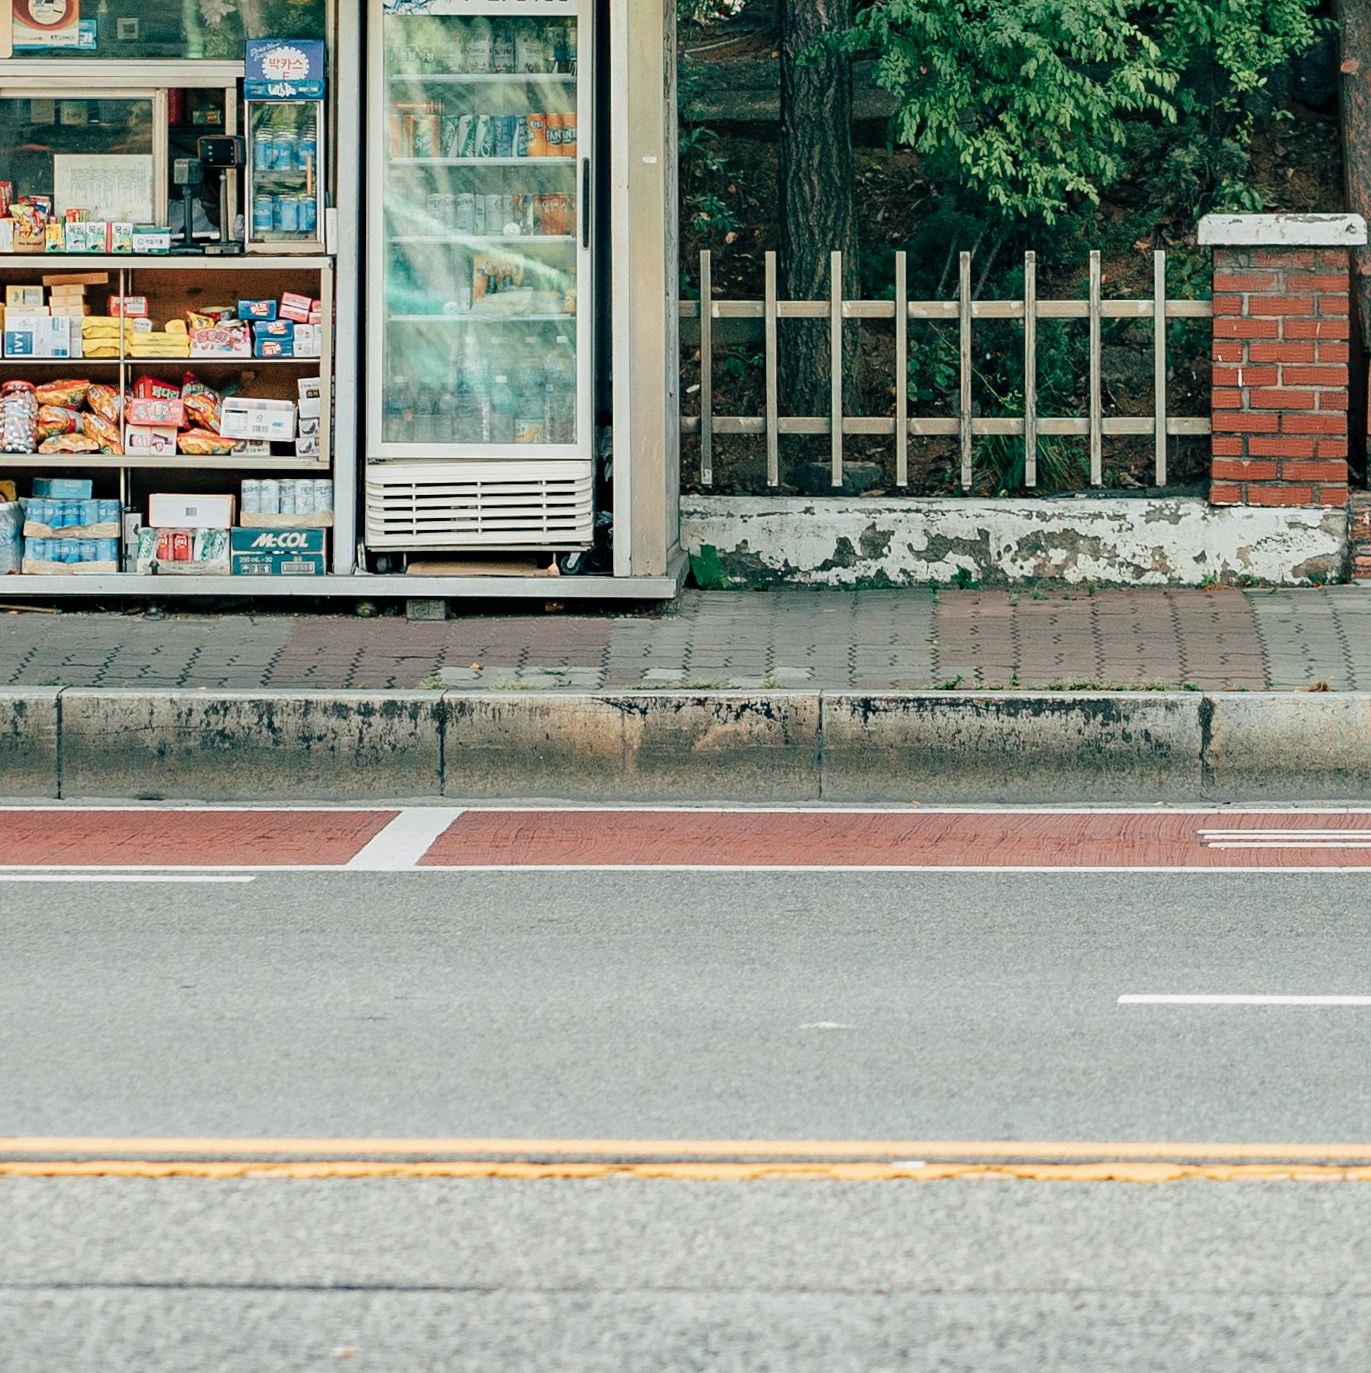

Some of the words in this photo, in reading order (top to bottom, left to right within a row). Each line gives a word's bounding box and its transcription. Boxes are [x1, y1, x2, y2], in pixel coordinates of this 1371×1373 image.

[268, 58, 304, 70] 박카스
[14, 332, 24, 353] IVY
[251, 532, 308, 548] McCOL
